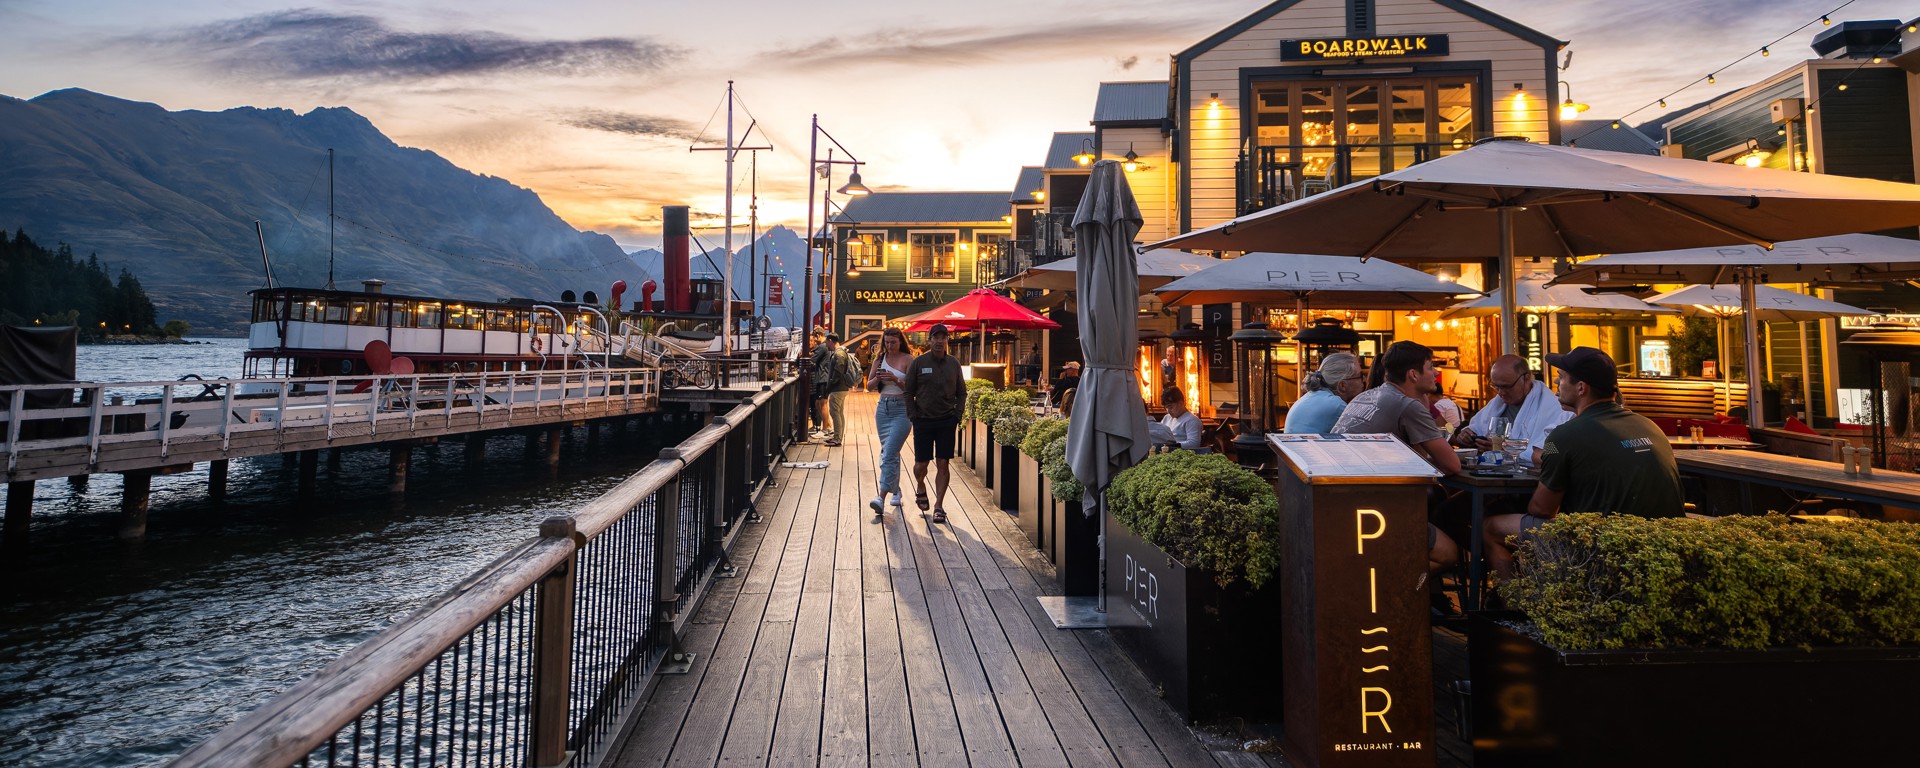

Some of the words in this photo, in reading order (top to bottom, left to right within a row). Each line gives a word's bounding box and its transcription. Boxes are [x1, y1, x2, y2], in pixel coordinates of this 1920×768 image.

[1301, 37, 1427, 55] BOARDWALK
[1266, 270, 1362, 283] PIER
[856, 290, 925, 299] BOARDWALK
[1213, 312, 1222, 365] PIER
[1526, 314, 1541, 371] PIER
[1126, 553, 1158, 620] PIER
[1357, 509, 1392, 734] PIER
[1335, 742, 1393, 751] RESTAURANT
[1403, 742, 1422, 750] BAR
